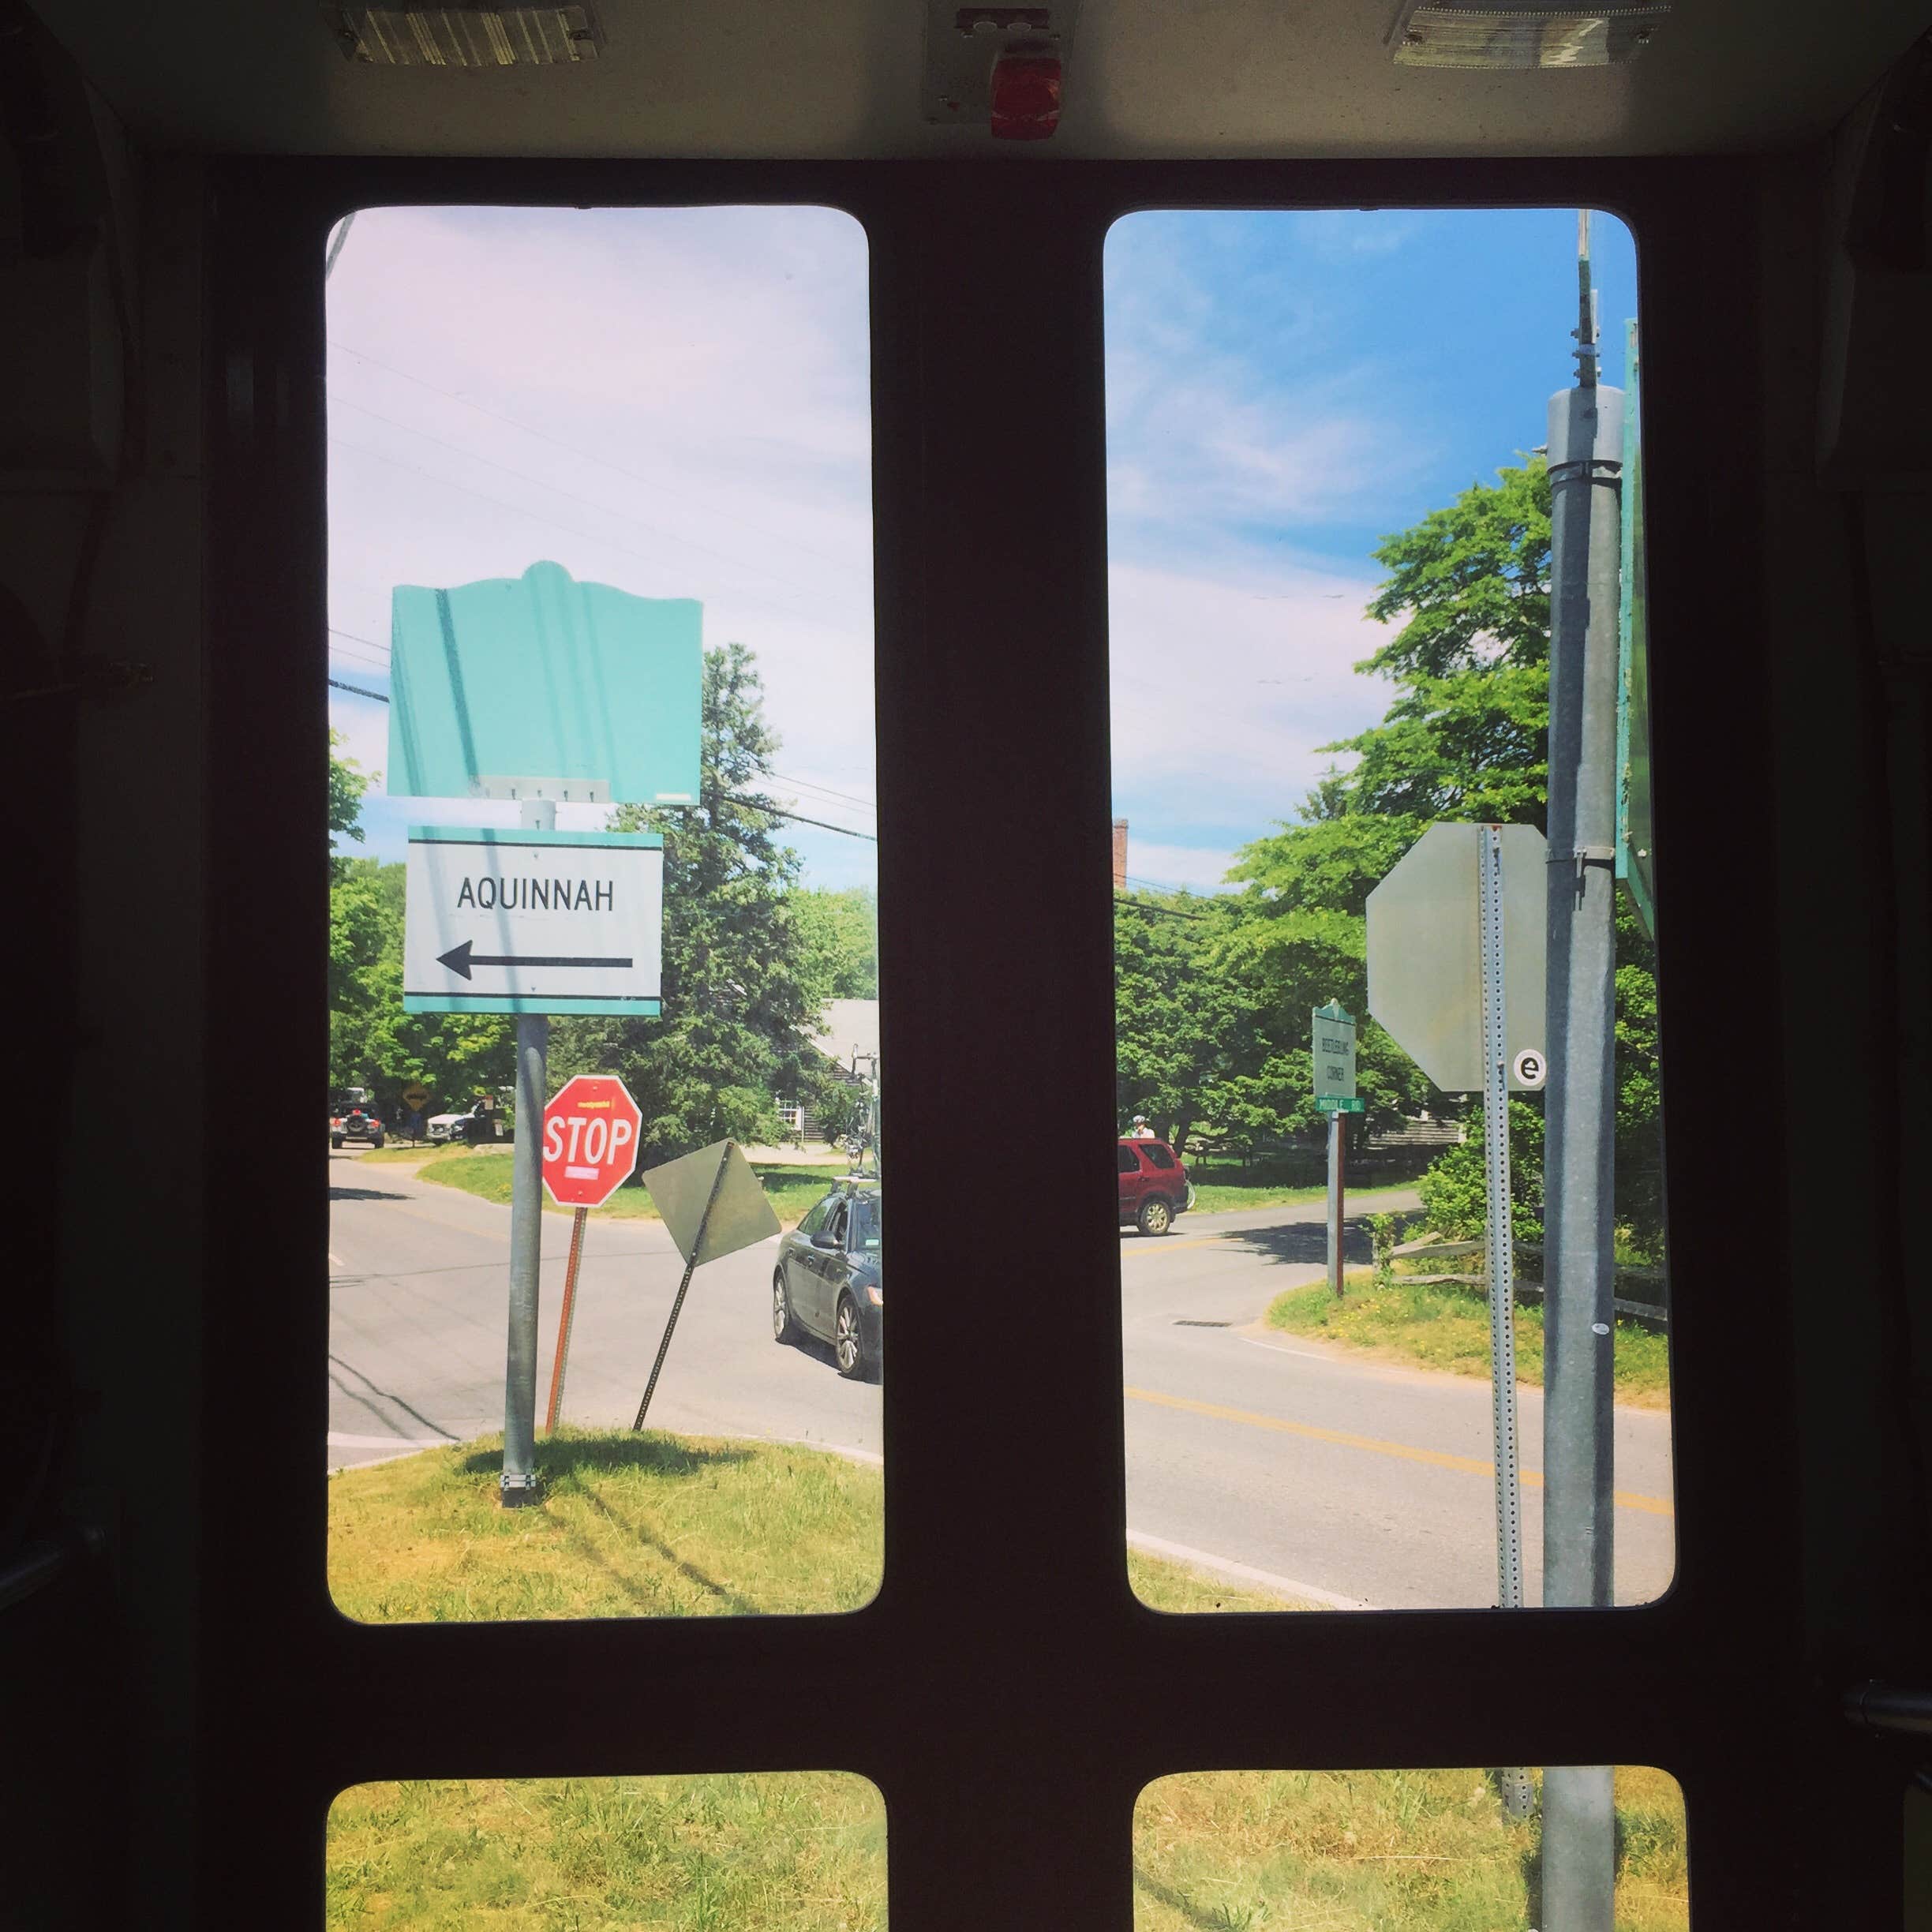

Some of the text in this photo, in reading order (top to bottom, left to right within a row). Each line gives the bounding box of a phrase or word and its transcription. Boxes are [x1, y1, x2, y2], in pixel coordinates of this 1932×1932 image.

[457, 877, 613, 911] AQUINNAH
[1319, 1099, 1344, 1110] MIDDLE
[543, 1115, 632, 1166] STOP
